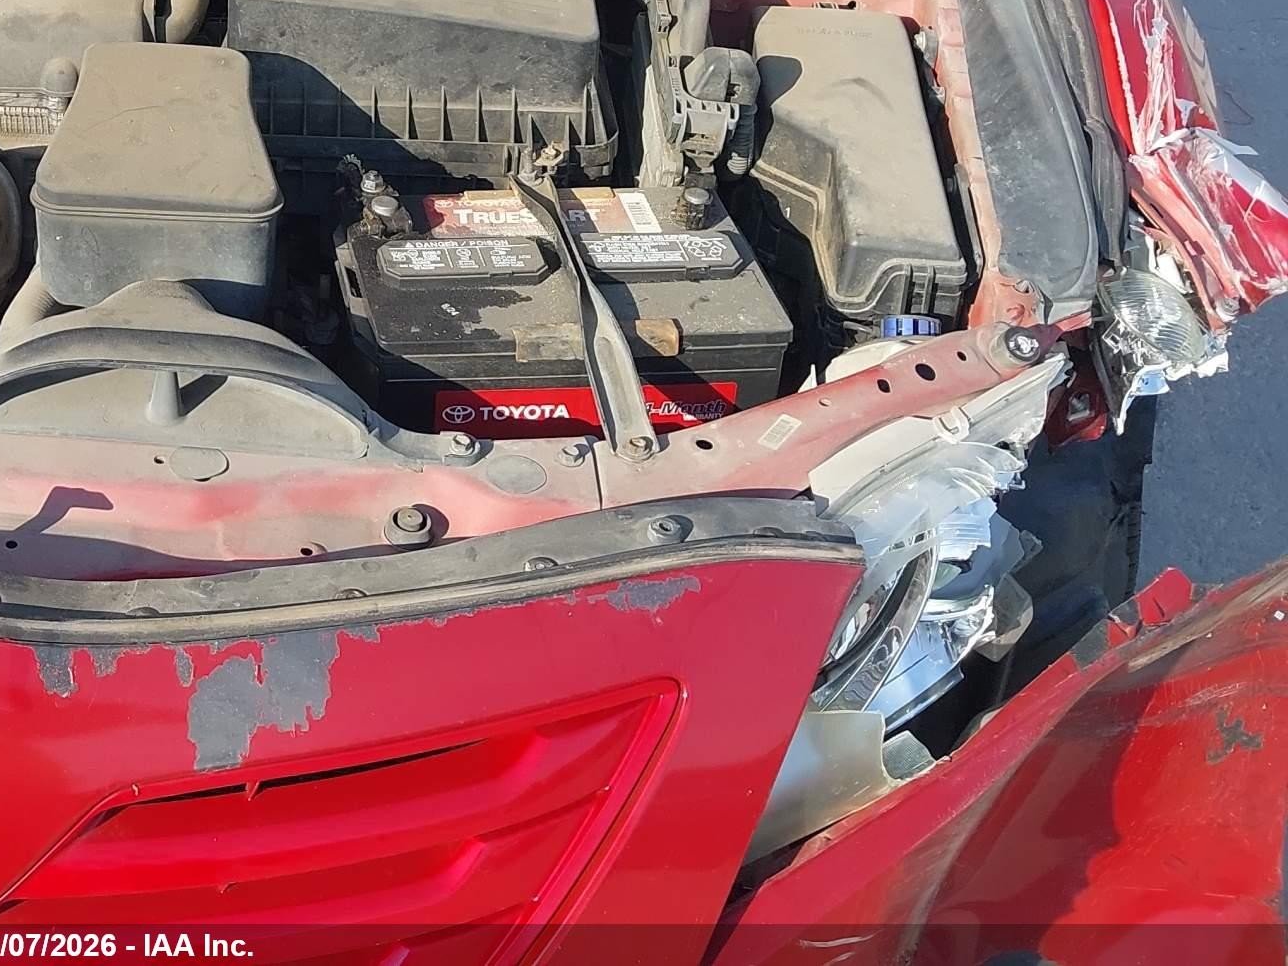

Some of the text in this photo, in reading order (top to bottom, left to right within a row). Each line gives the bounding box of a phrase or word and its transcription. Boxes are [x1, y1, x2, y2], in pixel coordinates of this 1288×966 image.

[415, 240, 459, 248] DANGER
[469, 239, 509, 247] POISON
[480, 404, 569, 420] TOYOTA
